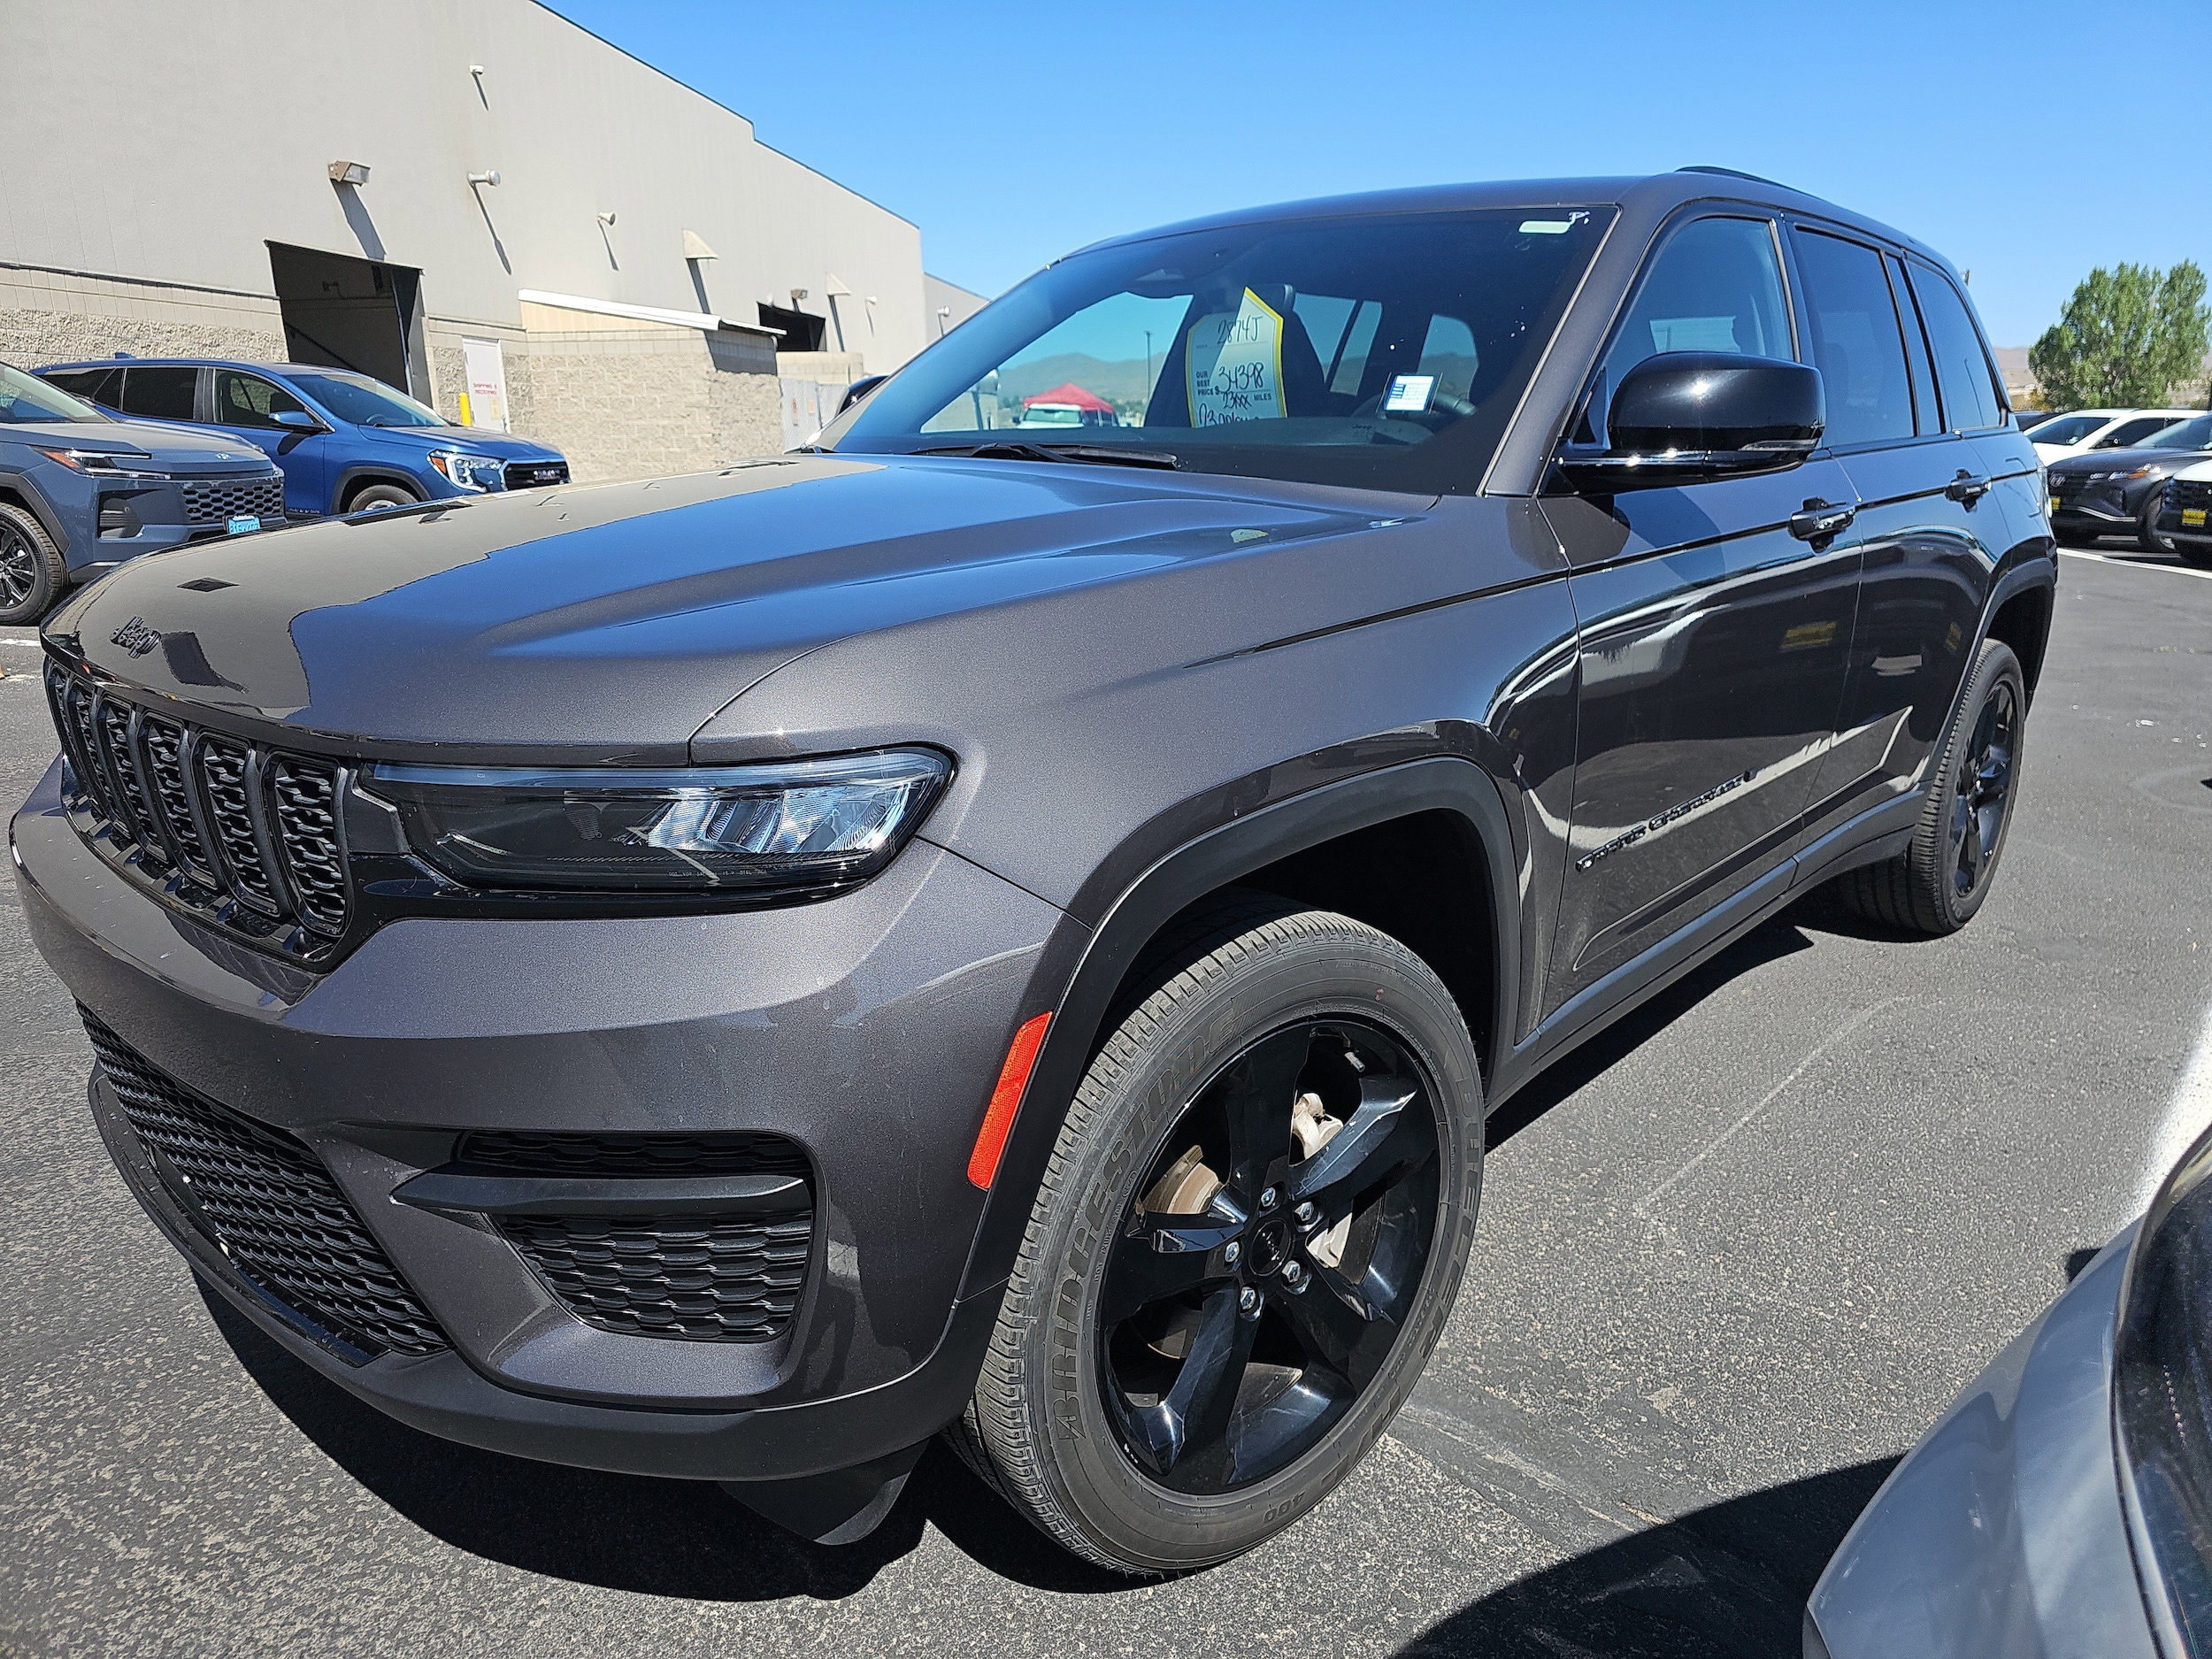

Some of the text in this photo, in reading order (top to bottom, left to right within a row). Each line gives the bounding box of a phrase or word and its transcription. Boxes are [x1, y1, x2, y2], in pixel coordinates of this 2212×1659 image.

[1218, 362, 1264, 393] 34398
[109, 615, 161, 660] Jeep
[1052, 1005, 1237, 1440] BRIDGESTONE
